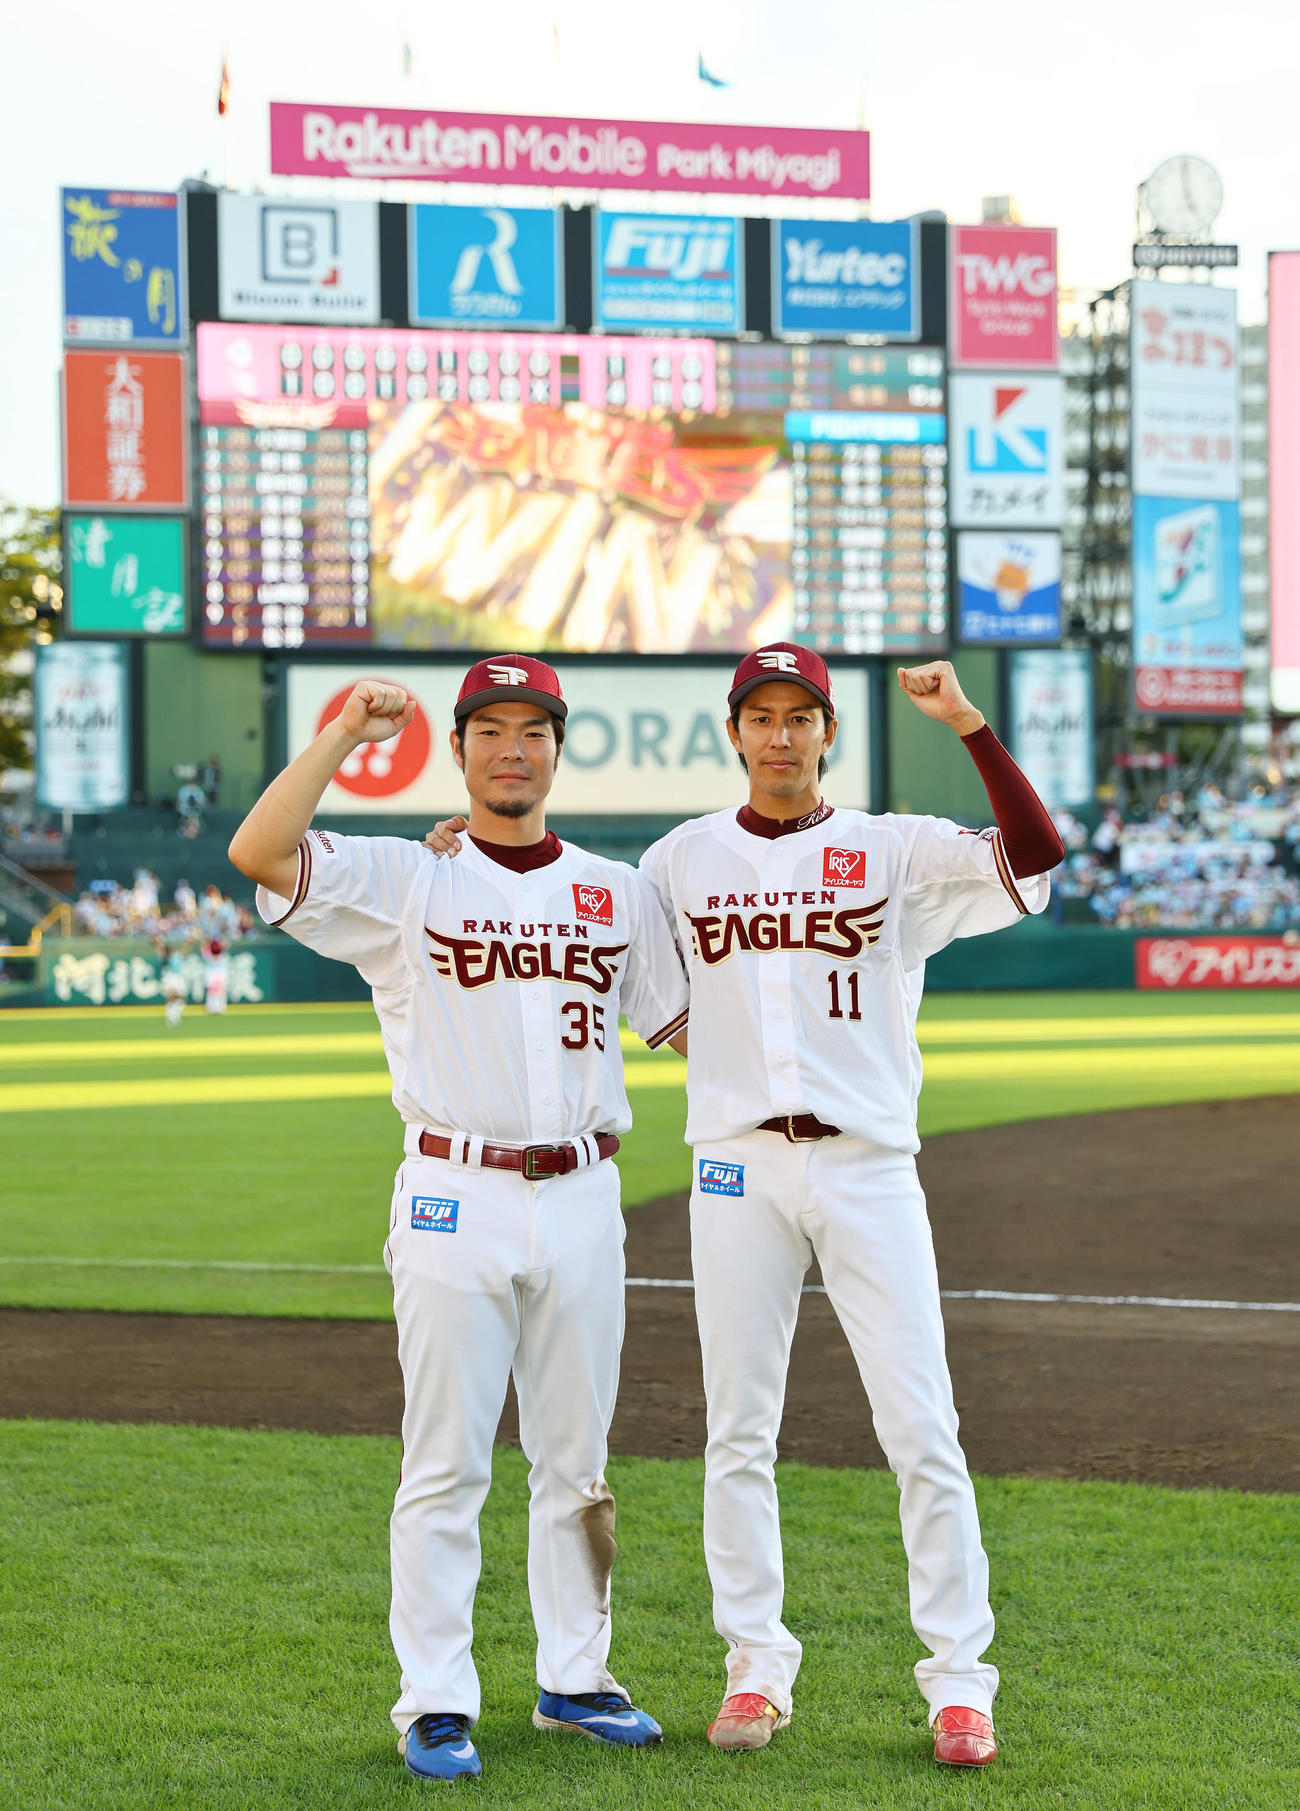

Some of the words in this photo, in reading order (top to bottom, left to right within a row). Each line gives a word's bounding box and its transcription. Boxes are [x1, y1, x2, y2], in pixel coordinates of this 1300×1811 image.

[303, 112, 498, 171] Rakuten
[505, 124, 647, 176] Mobile
[657, 143, 733, 180] Park
[736, 145, 841, 191] Miyagi
[281, 222, 316, 269] B
[604, 218, 732, 280] Fuji
[785, 237, 907, 286] Yurtec
[954, 252, 1056, 297] TWG
[967, 487, 1048, 514] カメイ
[829, 856, 850, 870] IRIS
[579, 891, 599, 907] IRIS
[707, 891, 836, 910] RAKUTEN
[823, 878, 864, 887] アイリスオーヤマ
[463, 920, 588, 938] RAKUTEN
[577, 911, 612, 925] アイリスオーヤマ
[683, 896, 889, 967] EAGLES
[424, 926, 629, 996] EAGLES
[827, 970, 862, 1022] 11
[560, 1001, 605, 1053] 35
[701, 1163, 740, 1183] Fuji
[415, 1200, 454, 1220] Fuji
